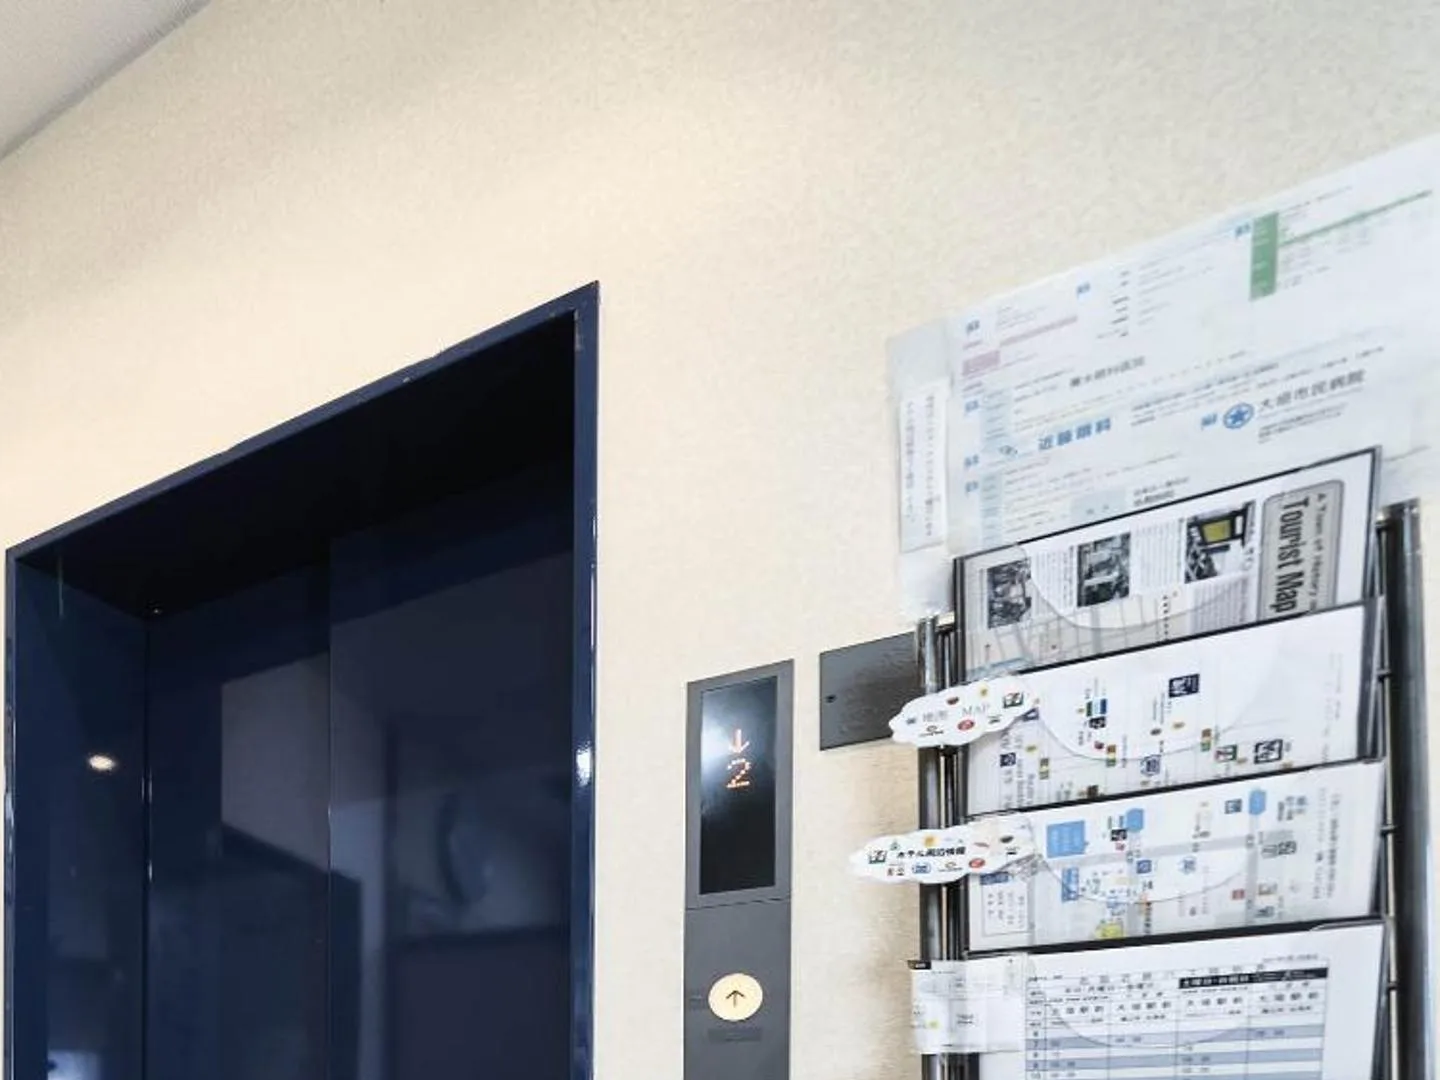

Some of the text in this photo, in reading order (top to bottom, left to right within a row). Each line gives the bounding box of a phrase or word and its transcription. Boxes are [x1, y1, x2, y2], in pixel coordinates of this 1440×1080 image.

[1269, 496, 1310, 613] Tourist Map
[726, 758, 751, 789] 2
